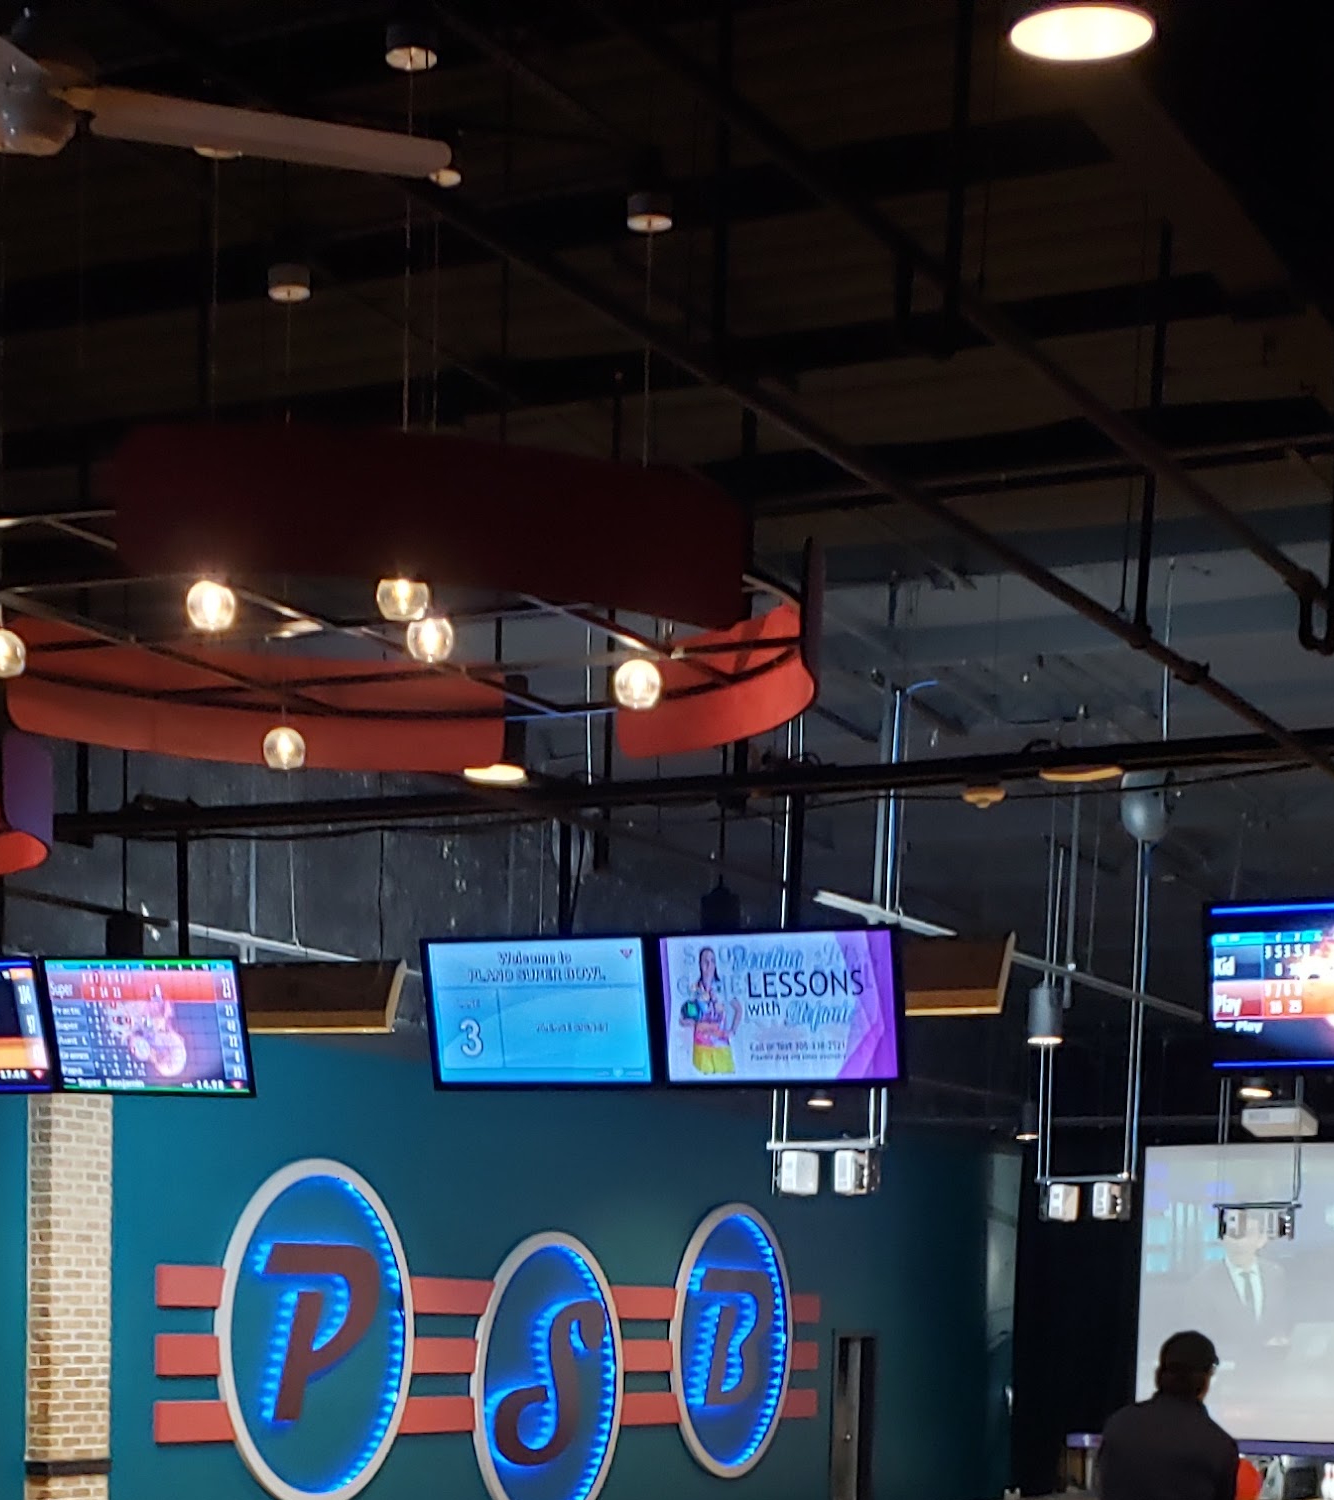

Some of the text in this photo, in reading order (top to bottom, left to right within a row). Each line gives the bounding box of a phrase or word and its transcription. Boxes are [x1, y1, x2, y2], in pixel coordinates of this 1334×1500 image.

[748, 970, 864, 998] LESSONS
[748, 1001, 781, 1016] with
[459, 1018, 484, 1058] 3
[262, 1243, 770, 1466] P S B
